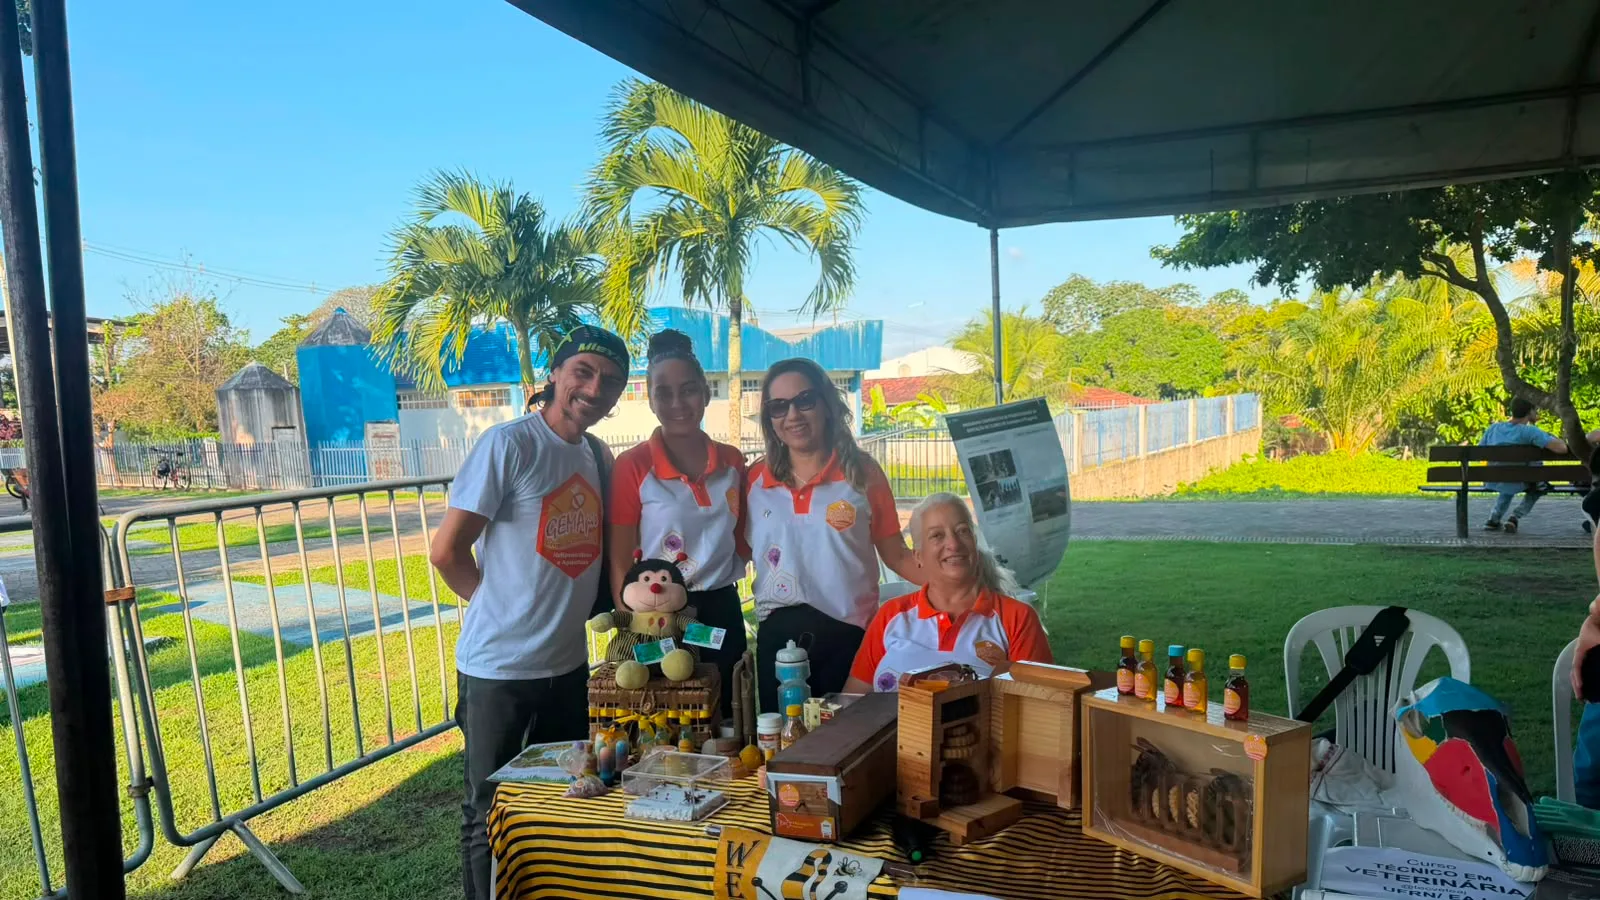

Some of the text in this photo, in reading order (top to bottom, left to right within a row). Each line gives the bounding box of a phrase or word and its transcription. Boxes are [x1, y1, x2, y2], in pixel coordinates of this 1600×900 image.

[1374, 862, 1494, 883] TÉCNICO EM
[1406, 858, 1457, 870] Curso
[1345, 865, 1528, 898] VETERINÁRIA
